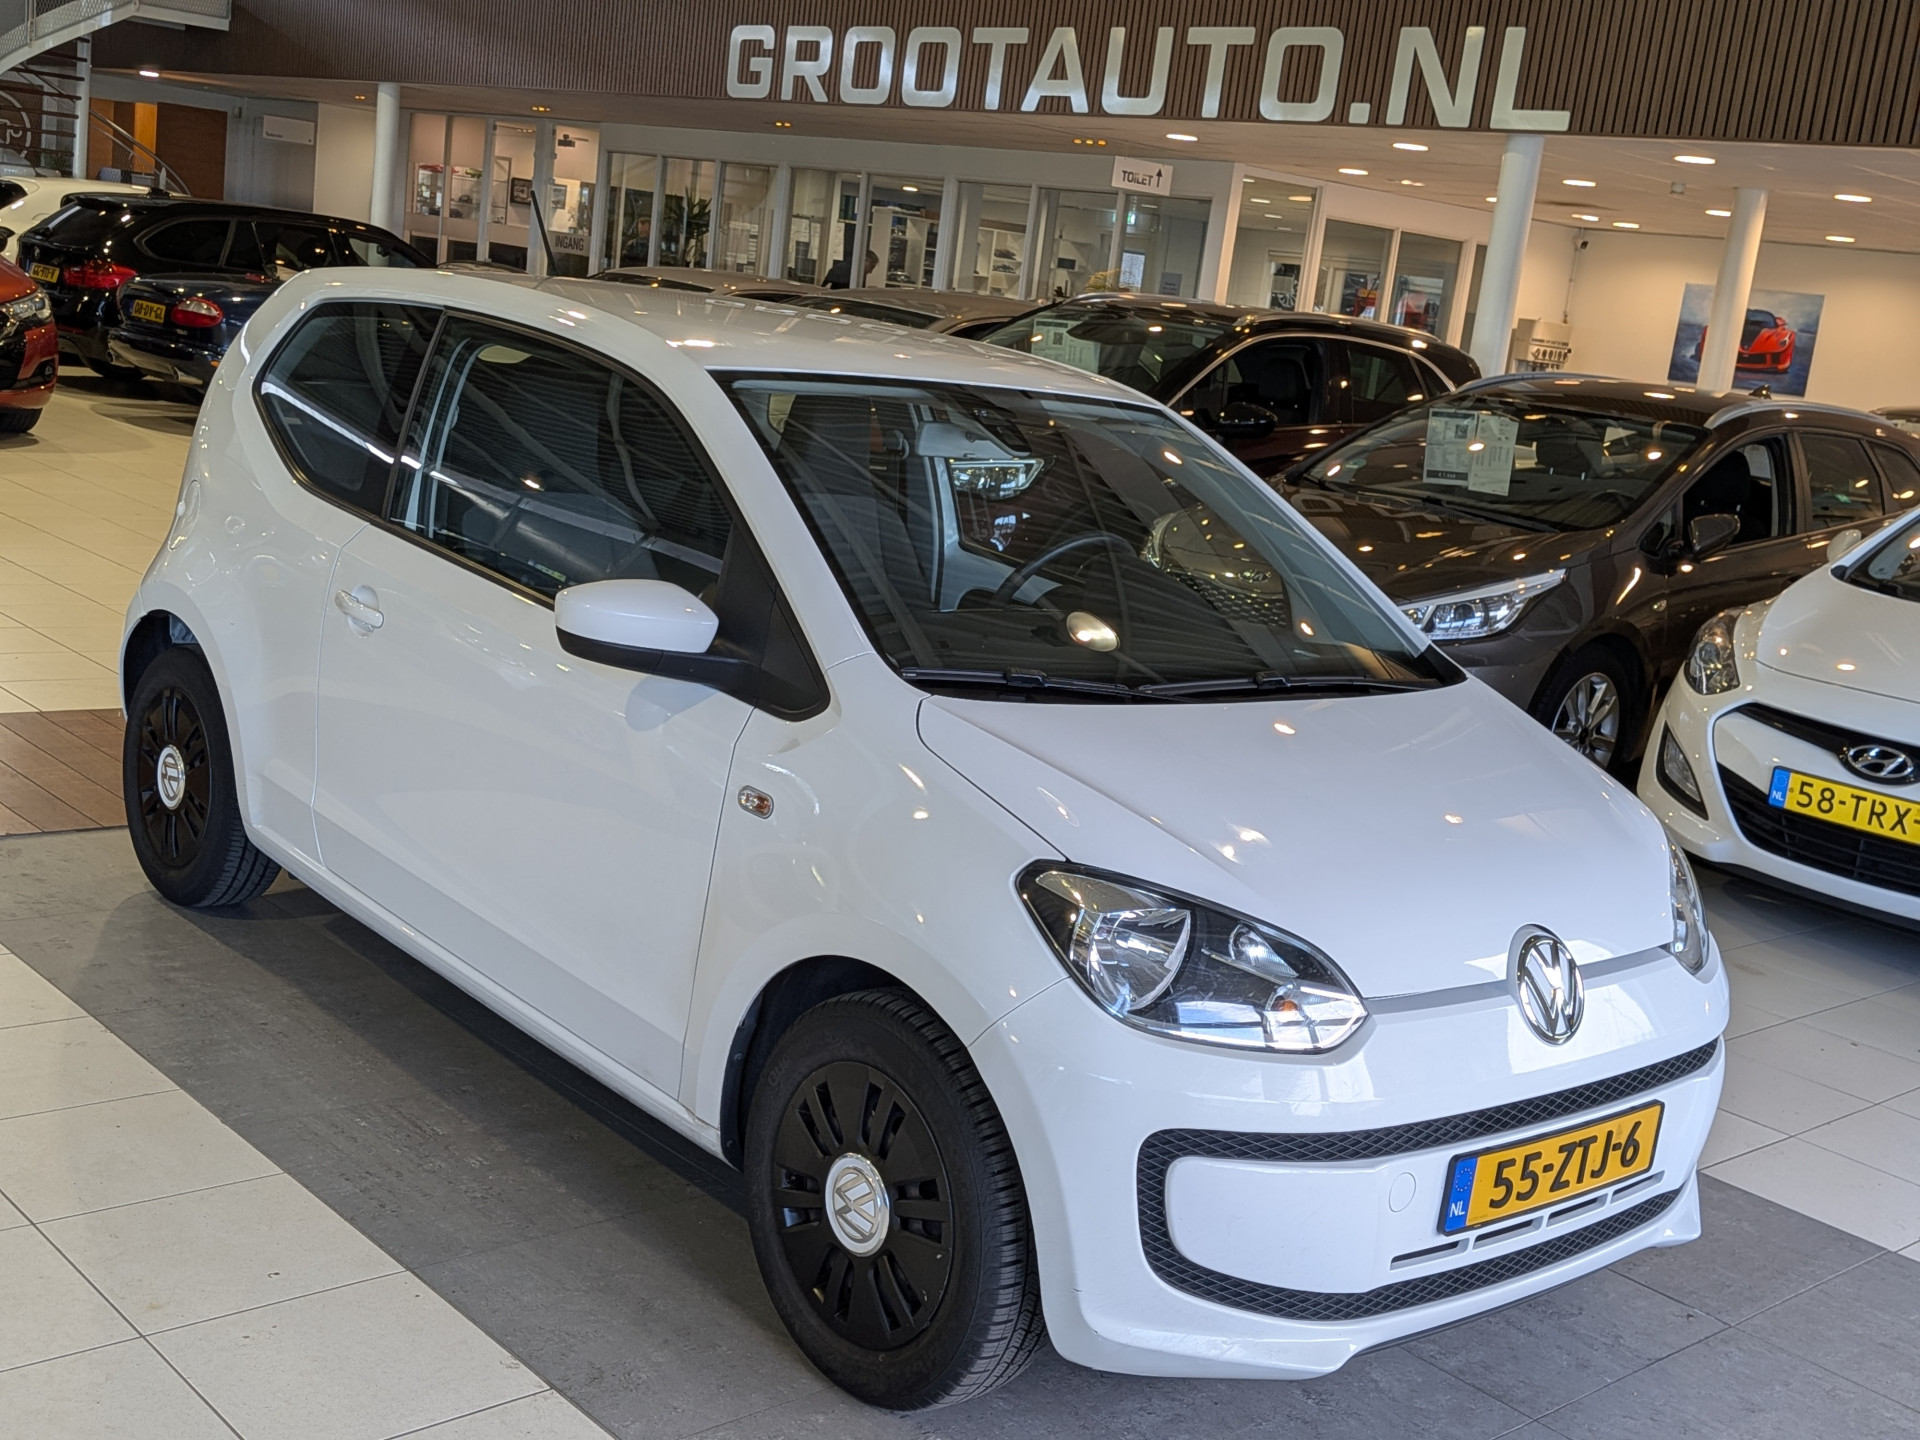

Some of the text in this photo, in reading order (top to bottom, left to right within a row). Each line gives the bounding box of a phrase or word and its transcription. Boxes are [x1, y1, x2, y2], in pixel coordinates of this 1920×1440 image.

[726, 25, 1571, 131] GROOTAUTO.NL
[1122, 170, 1154, 187] TOILET
[555, 235, 584, 251] INGANG
[1771, 790, 1784, 801] NL
[1489, 1120, 1643, 1209] 55-ZTJ-6
[1450, 1200, 1466, 1217] NL
